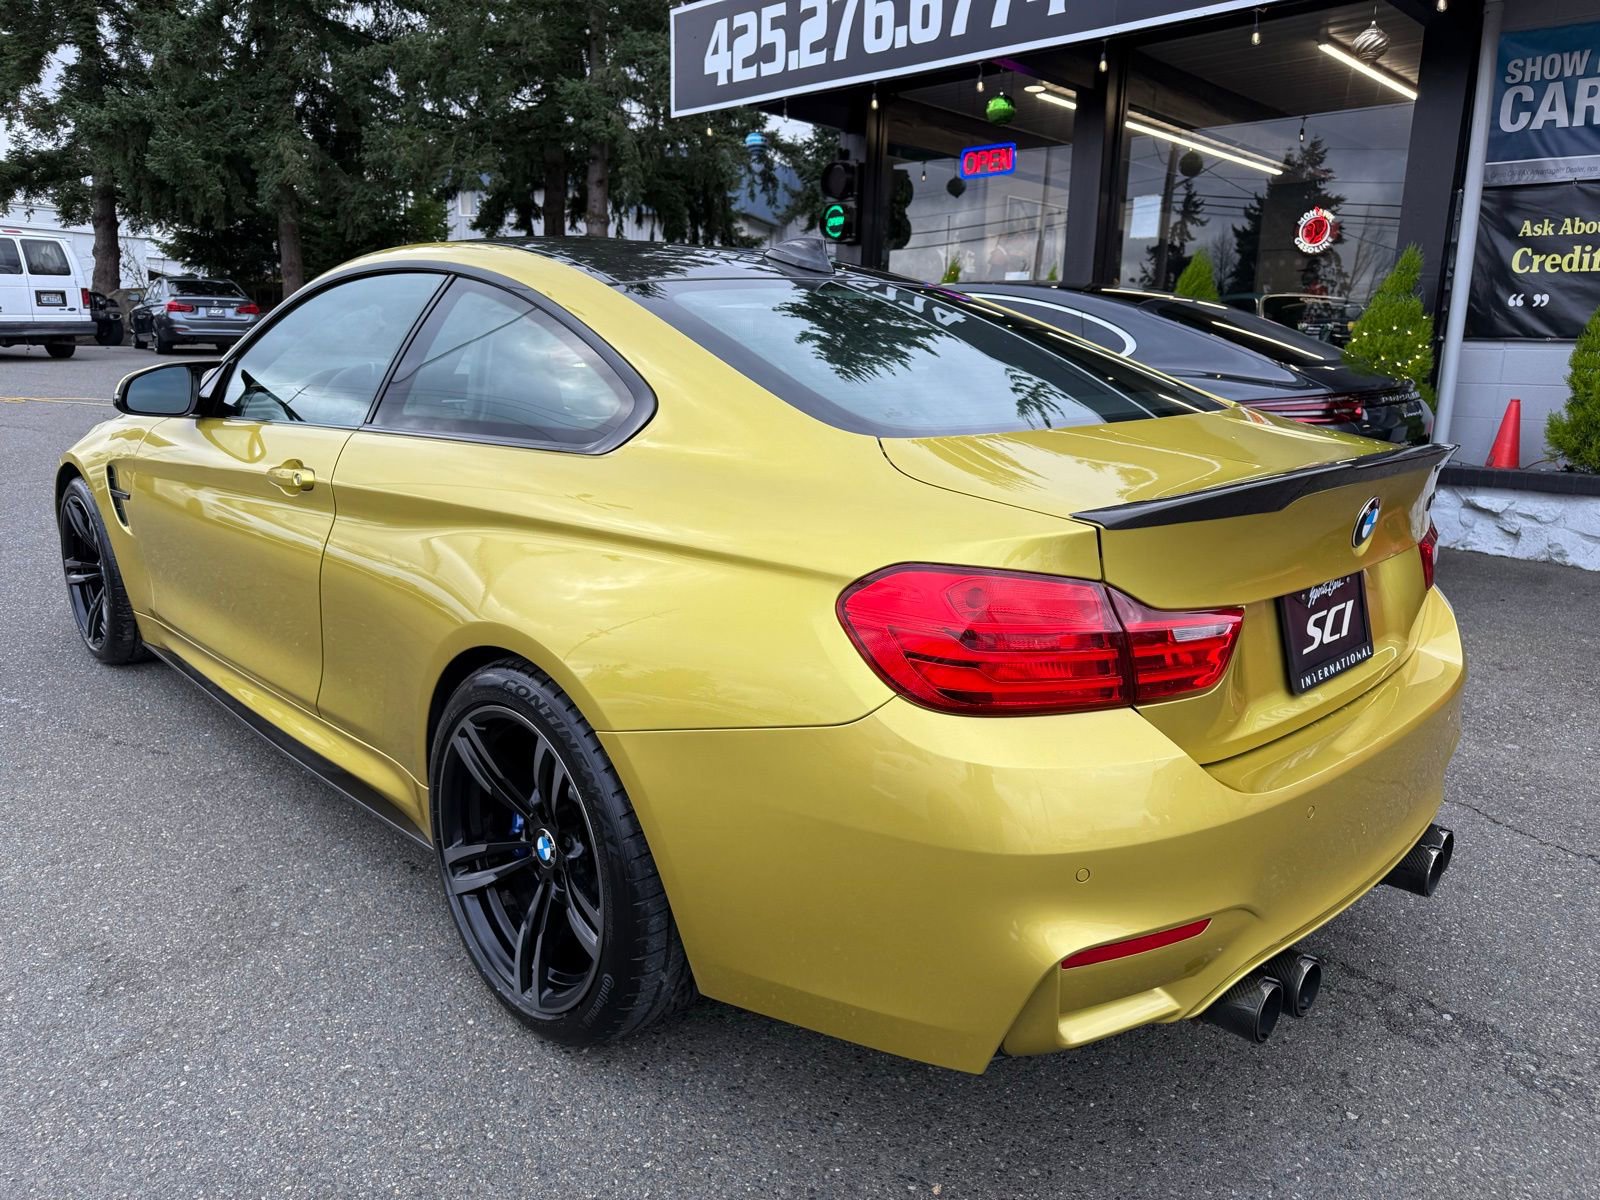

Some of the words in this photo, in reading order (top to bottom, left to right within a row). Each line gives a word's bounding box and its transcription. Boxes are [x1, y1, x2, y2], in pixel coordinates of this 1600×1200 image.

[704, 0, 1066, 86] 425.276.6
[1504, 48, 1592, 84] SHOW
[963, 147, 1013, 175] OPEN
[1294, 236, 1333, 253] GASOLINE
[1518, 218, 1555, 237] Ask
[1558, 217, 1600, 235] Abo
[1302, 600, 1355, 655] SCI
[1301, 645, 1372, 688] INTERNATIONAL
